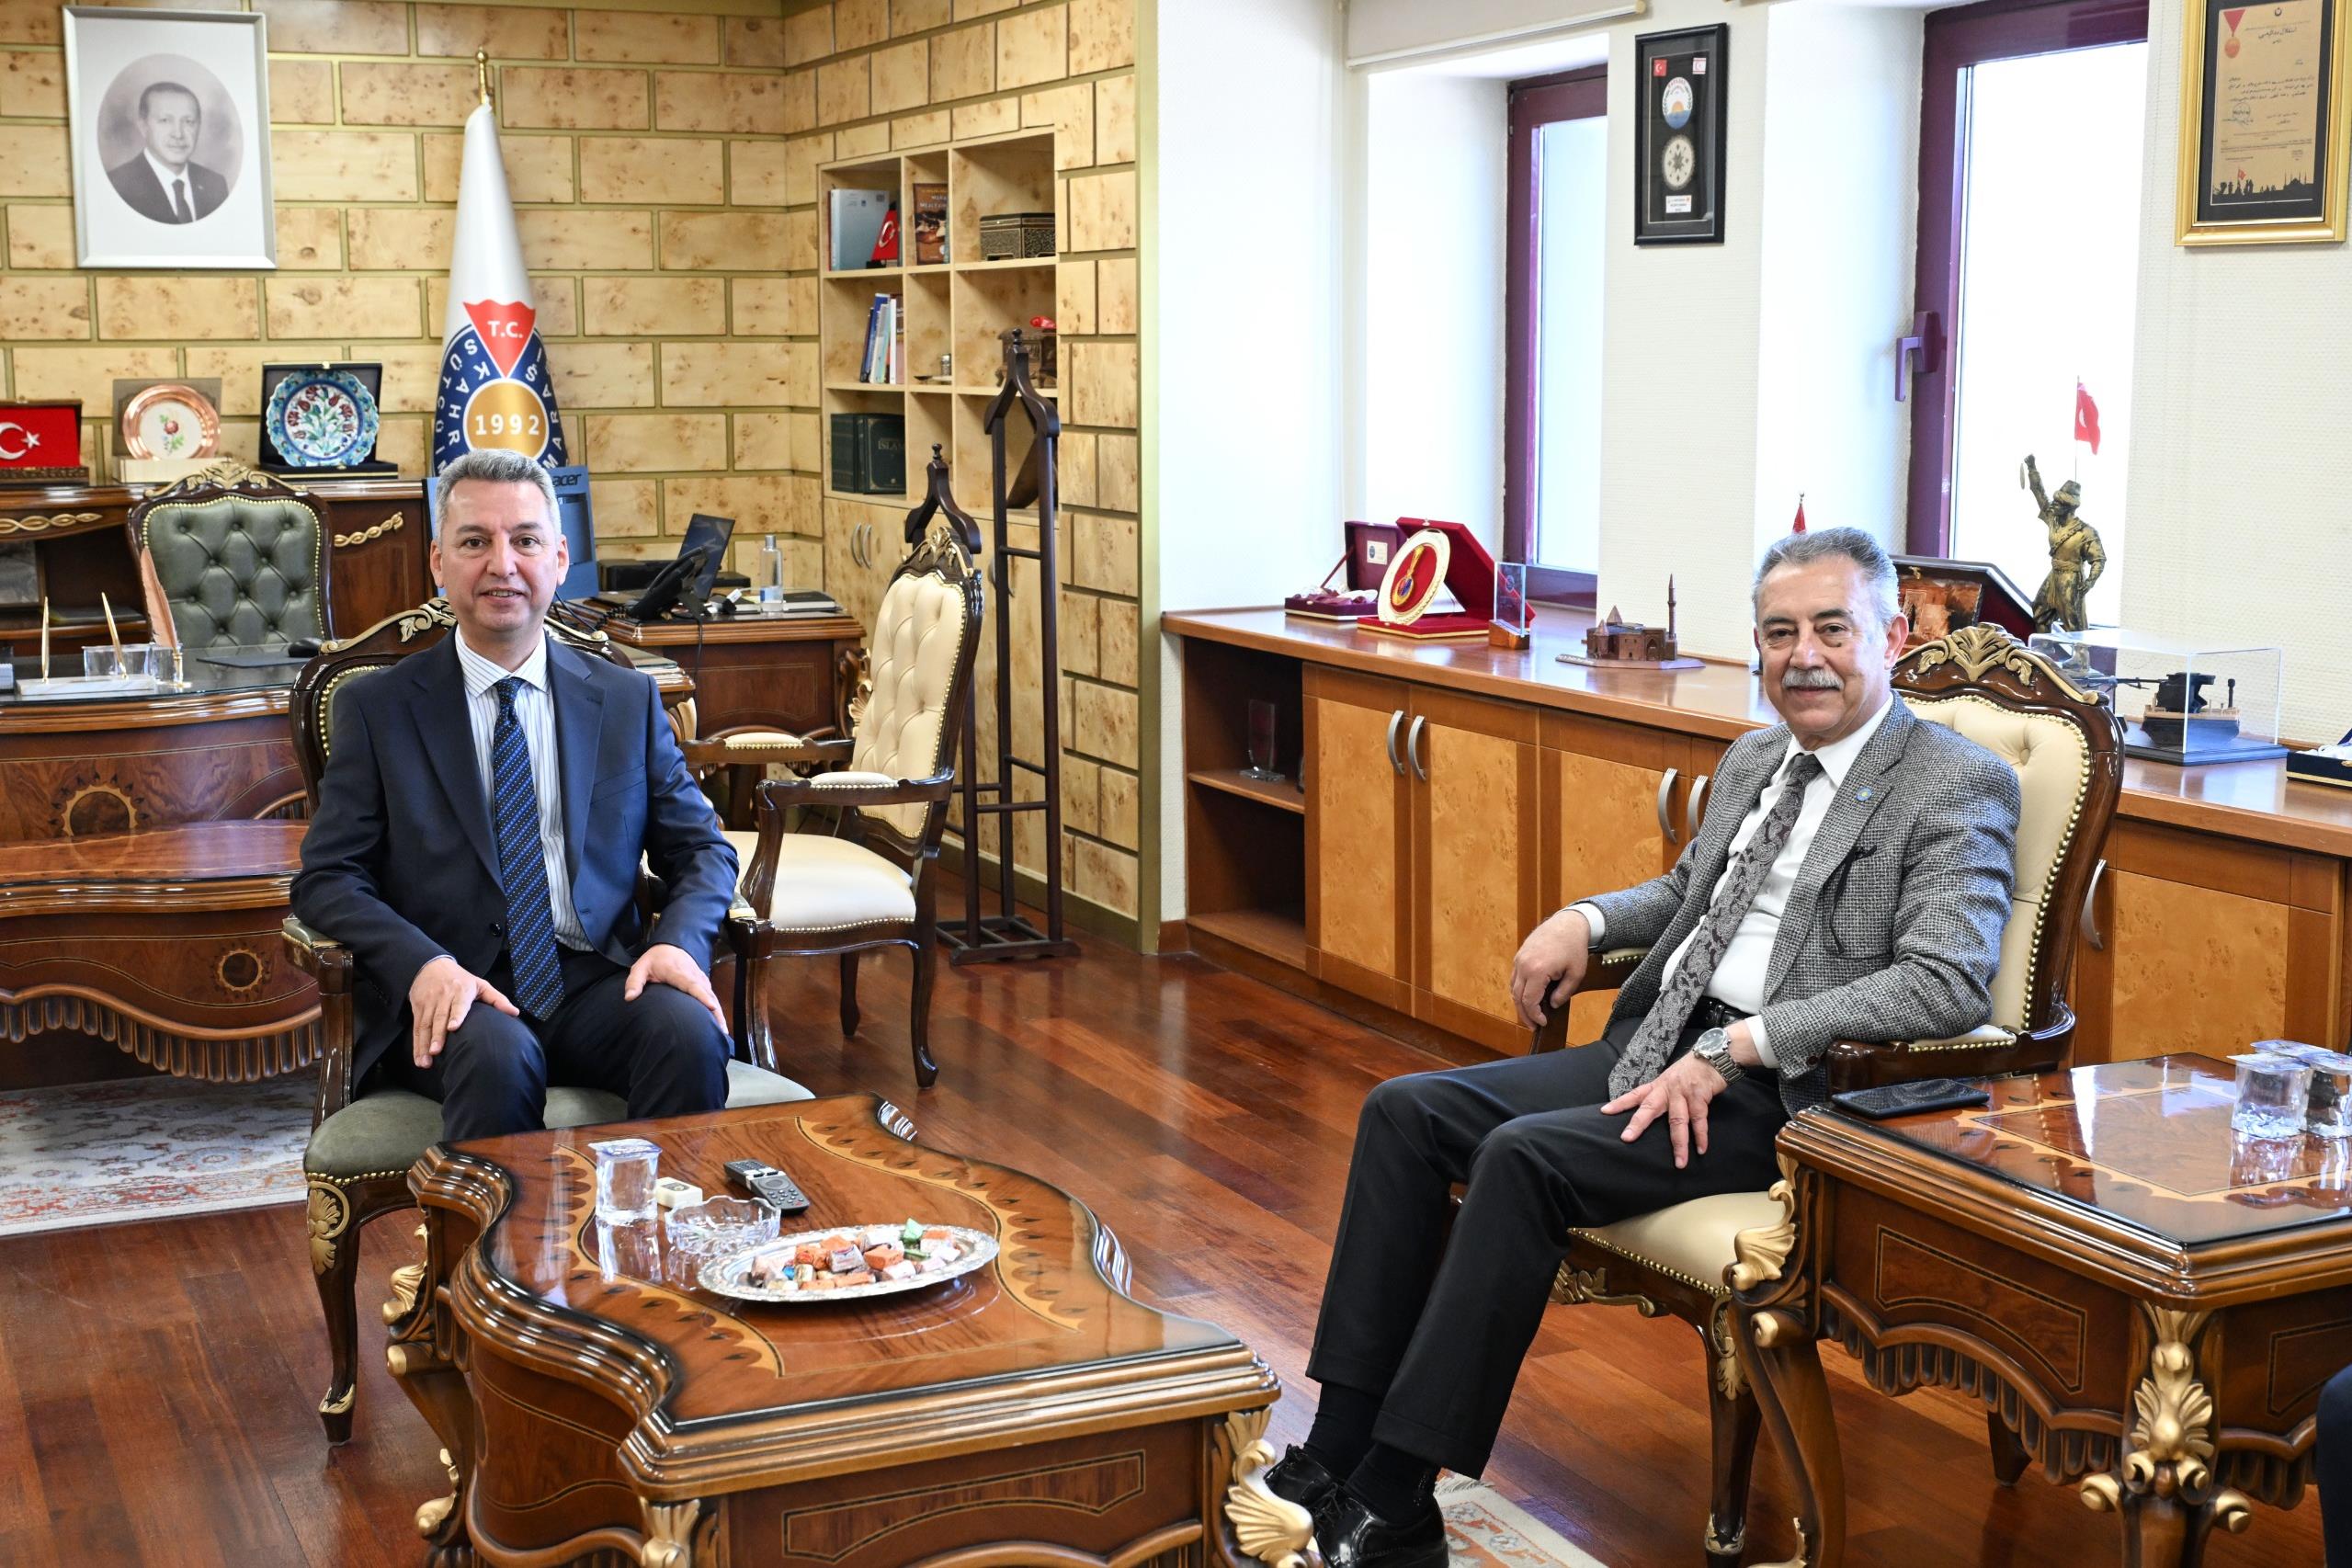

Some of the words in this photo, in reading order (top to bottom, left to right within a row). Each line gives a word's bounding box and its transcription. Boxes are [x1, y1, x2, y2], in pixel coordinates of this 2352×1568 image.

[487, 320, 523, 339] T.C.
[475, 414, 540, 436] 1992
[551, 473, 582, 487] acer
